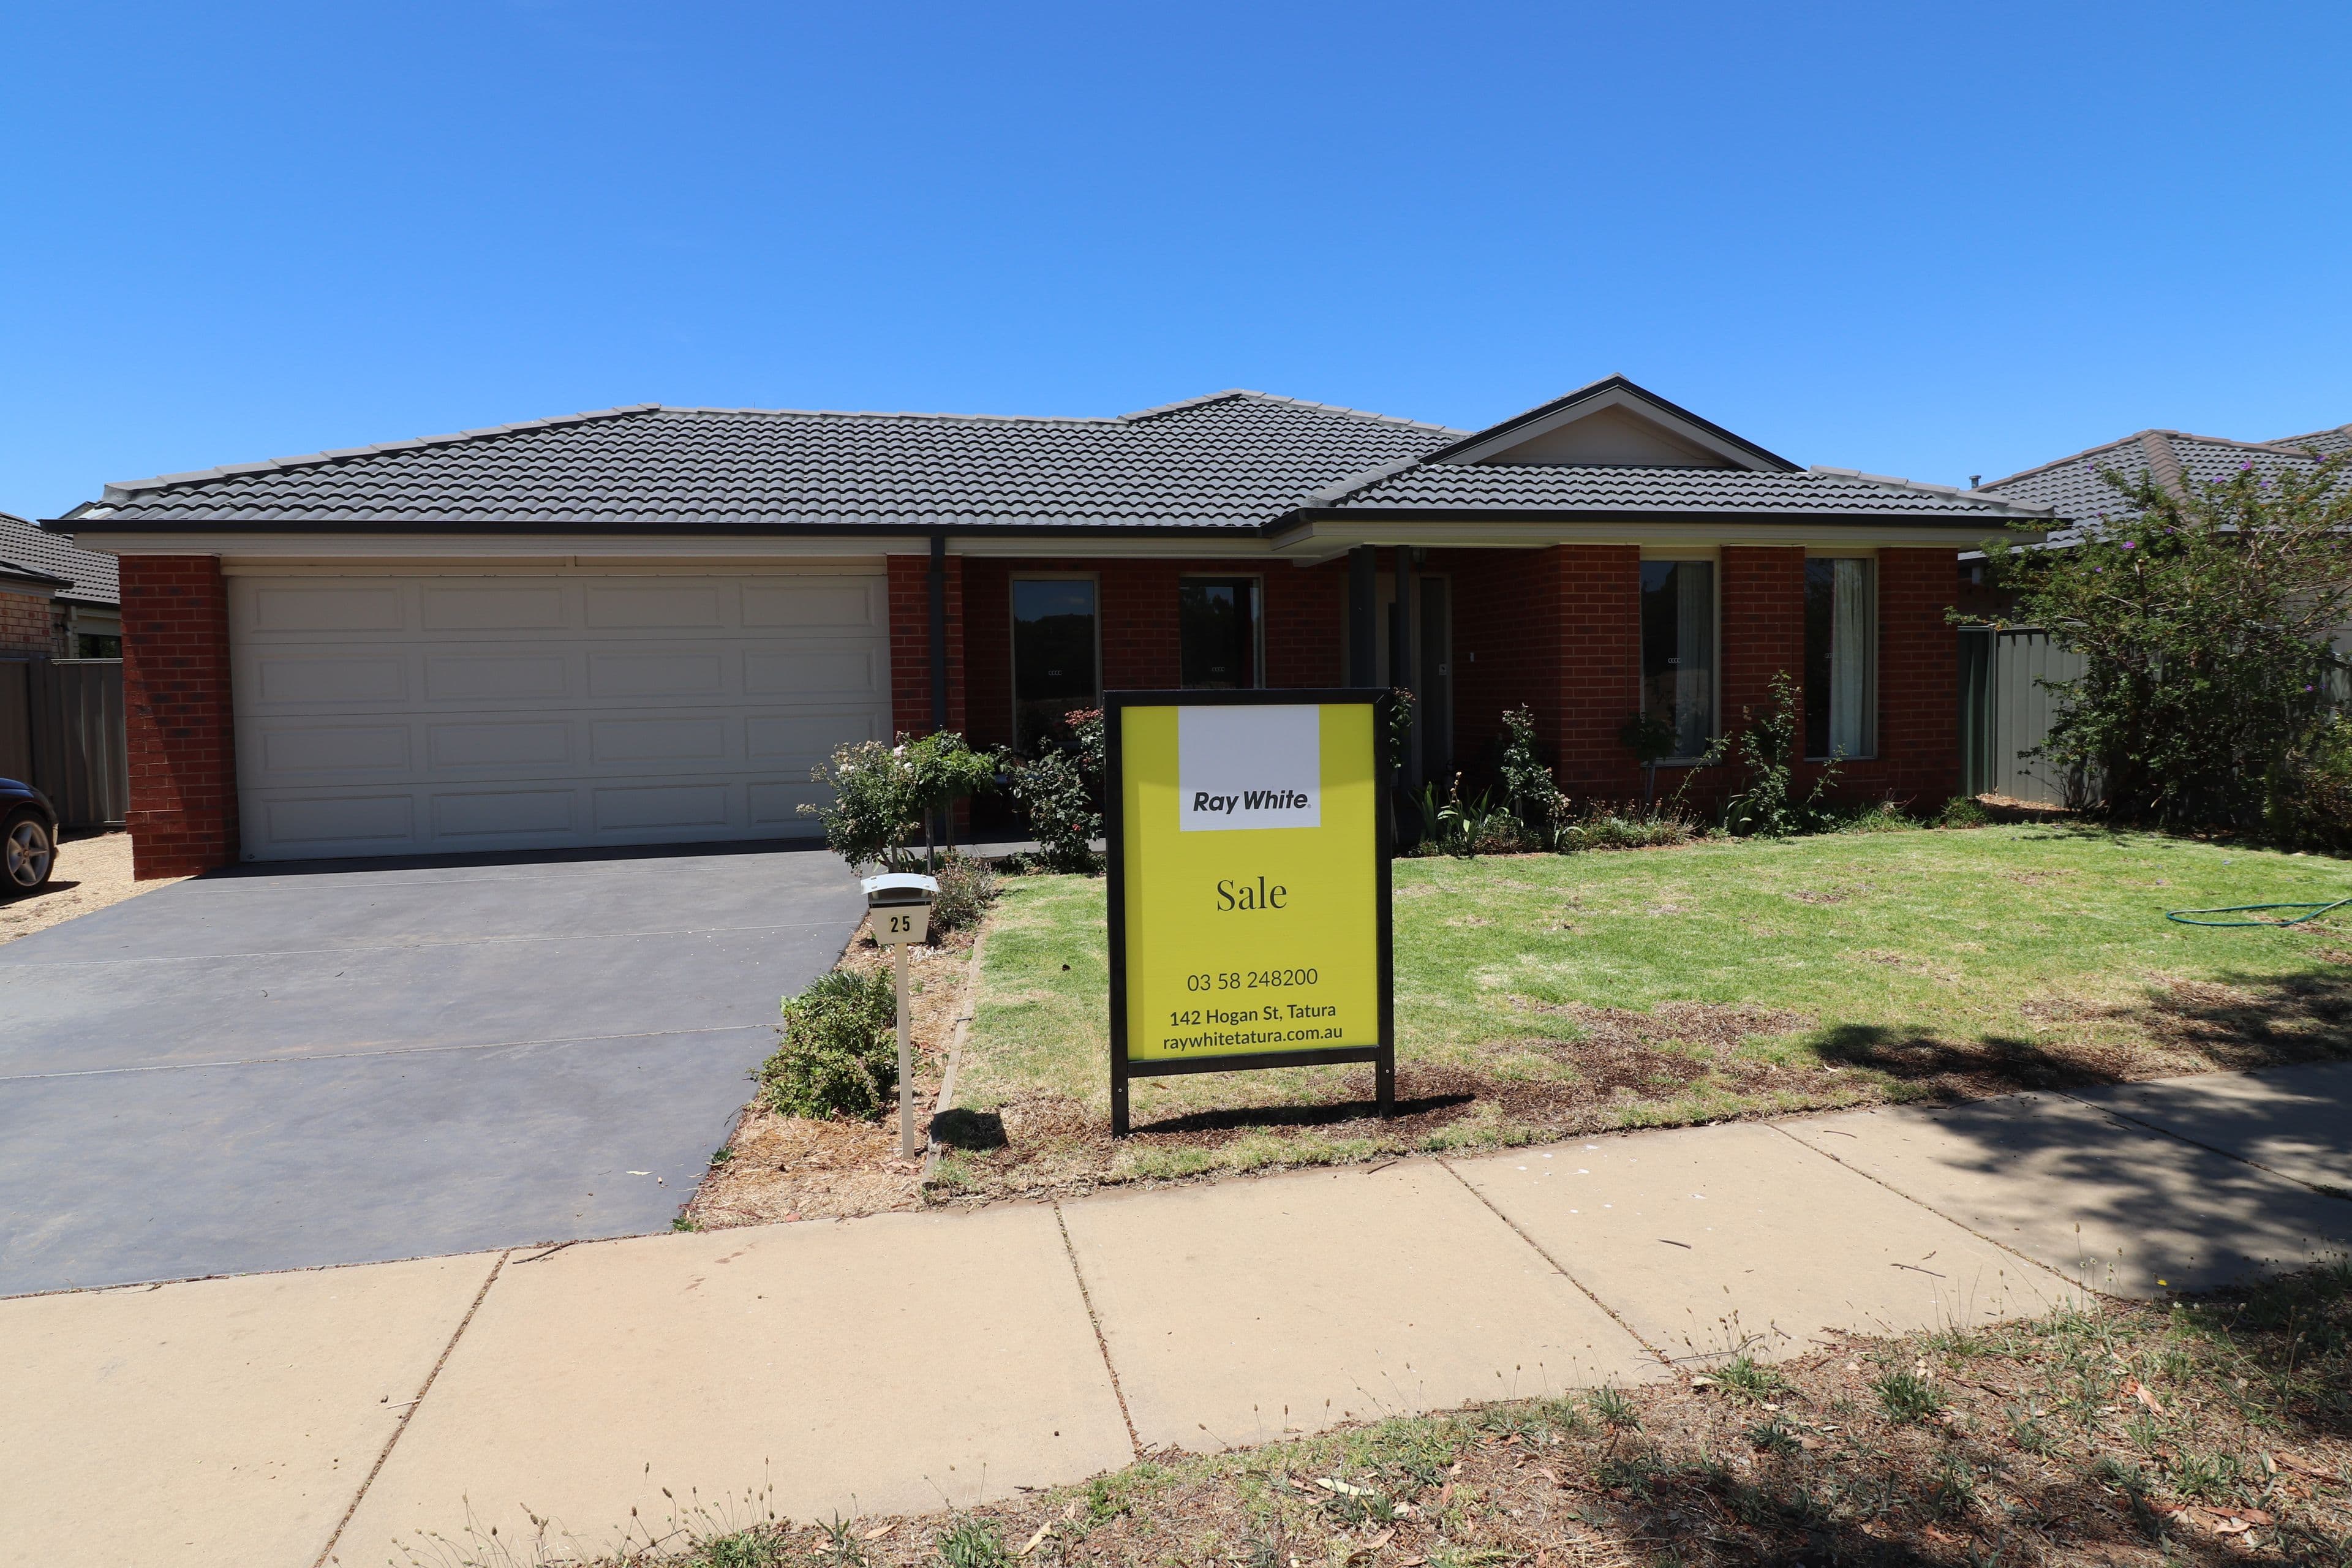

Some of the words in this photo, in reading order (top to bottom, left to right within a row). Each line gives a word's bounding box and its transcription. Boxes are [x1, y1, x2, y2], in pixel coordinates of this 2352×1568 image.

[1193, 792, 1239, 815] Ray
[1243, 790, 1308, 810] White
[1216, 876, 1287, 911] Sale
[891, 916, 910, 933] 25
[1187, 974, 1211, 992] 03
[1218, 972, 1241, 990] 58
[1247, 968, 1318, 988] 248200
[1170, 1010, 1201, 1026] 142
[1207, 1009, 1258, 1026] Hogan
[1263, 1006, 1283, 1022] St,
[1287, 1004, 1336, 1019] Tatura
[1164, 1027, 1343, 1052] raywhitetatura.com.au
